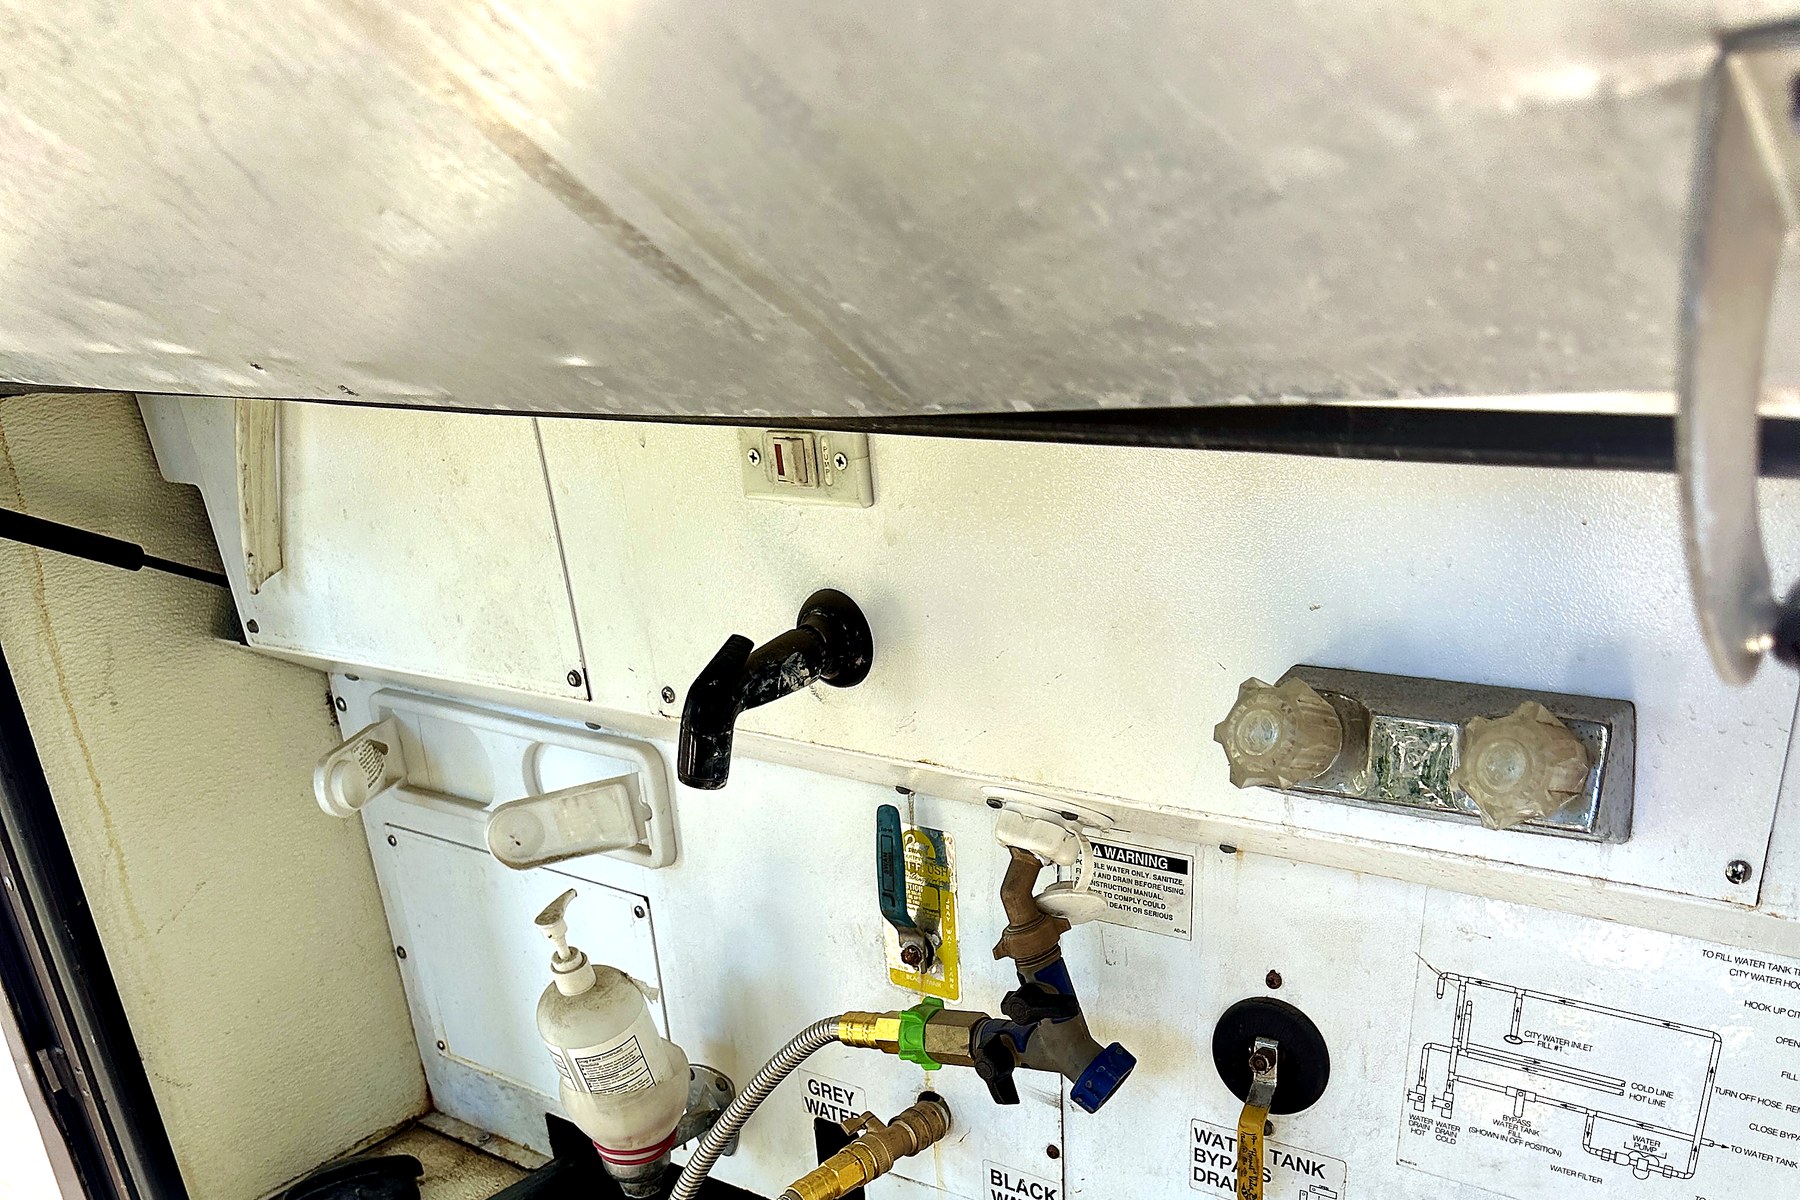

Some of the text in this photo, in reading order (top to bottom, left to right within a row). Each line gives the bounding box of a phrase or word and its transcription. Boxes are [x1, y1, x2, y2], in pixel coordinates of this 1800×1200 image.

[1104, 846, 1168, 869] WARNING
[1106, 864, 1130, 875] WATER
[1097, 872, 1112, 881] AND
[1112, 876, 1133, 885] DRAIN
[1134, 879, 1161, 891] BEFORE
[1113, 894, 1141, 905] COMPLY
[1142, 899, 1166, 911] COULD
[1109, 901, 1173, 921] DEATH OR SERIOUS
[1702, 949, 1714, 958] TO
[1715, 952, 1733, 962] FILL
[1734, 956, 1766, 969] WATER
[1767, 962, 1792, 975] TANK
[1729, 968, 1751, 979] CITY
[1750, 973, 1783, 986] WATER
[1744, 1000, 1772, 1012] HOOK
[1773, 1006, 1787, 1015] UP
[1524, 1030, 1593, 1052] CITY WATER INLET
[1537, 1041, 1563, 1052] FILL #1
[1781, 1070, 1799, 1081] FILL
[808, 1079, 854, 1106] GREY
[1631, 1082, 1674, 1099] COLD LINE
[1714, 1086, 1738, 1099] TURN
[1739, 1092, 1757, 1102] OFF
[1629, 1093, 1666, 1108] HOT LINE
[1408, 1120, 1431, 1131] DRAIN
[1409, 1113, 1434, 1125] WATER
[1435, 1120, 1461, 1133] WATER
[1502, 1115, 1532, 1128] BYPASS
[1410, 1127, 1426, 1137] HOT
[1435, 1126, 1458, 1139] DRAIN
[1492, 1119, 1540, 1137] WATER TANK
[1507, 1130, 1522, 1139] FILL
[1748, 1122, 1778, 1137] CLOSE
[1435, 1134, 1456, 1145] COLD
[1468, 1127, 1562, 1157] (SHOWN IN OFF POSITION)
[1632, 1134, 1661, 1148] WATER
[1634, 1142, 1657, 1153] PUMP
[1194, 1127, 1326, 1180] WAT TANK
[1730, 1145, 1799, 1169] TO WATER TANK
[1194, 1148, 1272, 1183] BYPS
[1193, 1167, 1238, 1193] DRAI
[1550, 1164, 1603, 1184] WATER FILTER
